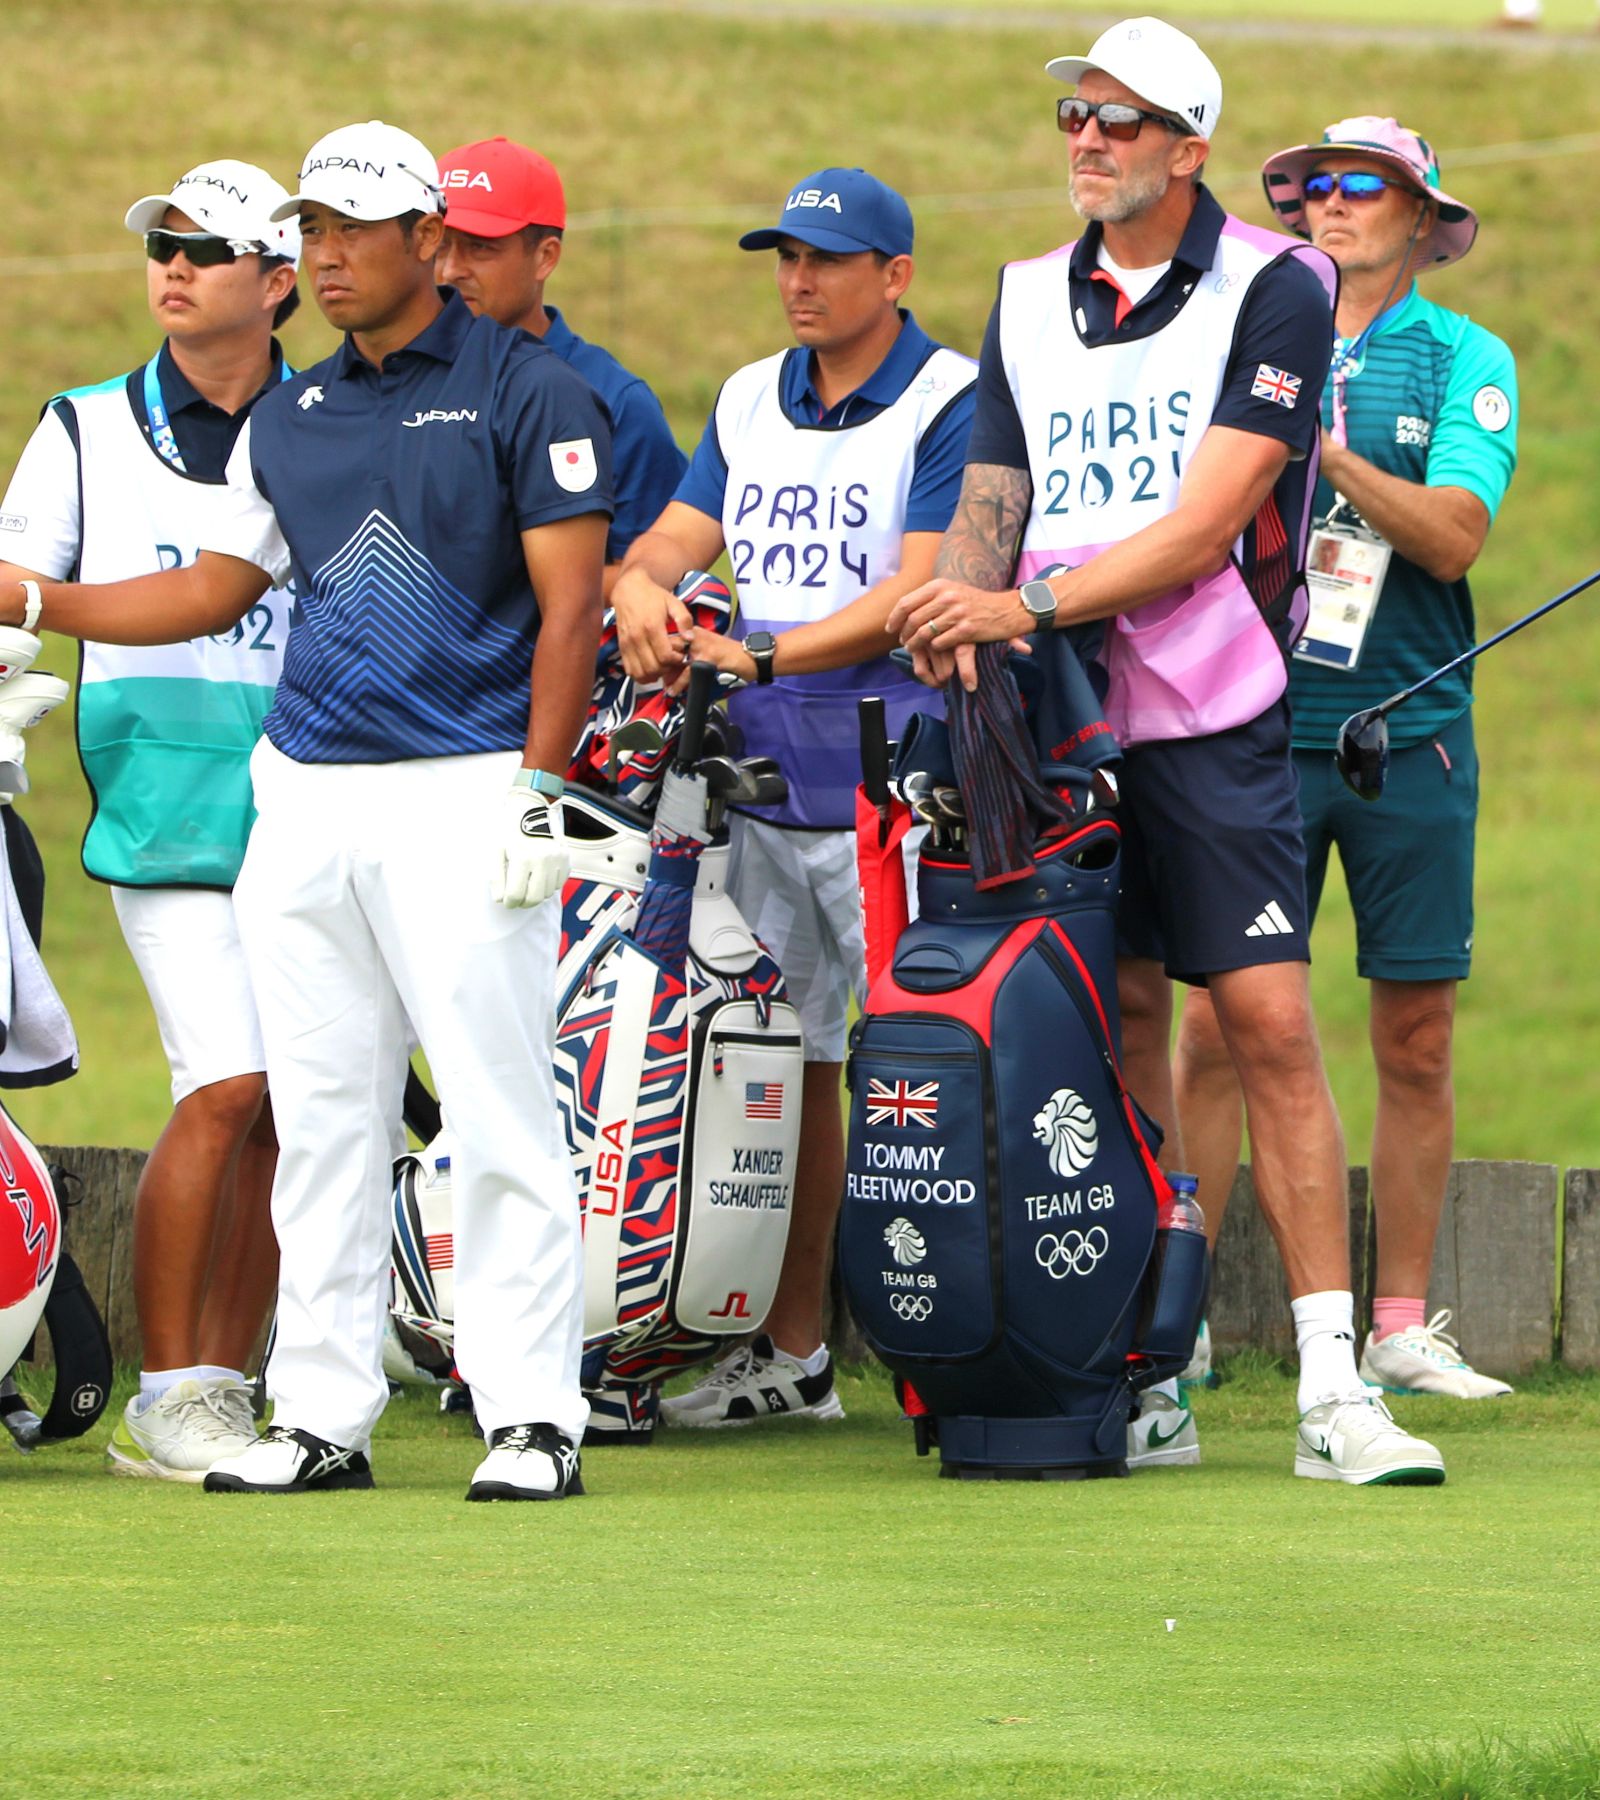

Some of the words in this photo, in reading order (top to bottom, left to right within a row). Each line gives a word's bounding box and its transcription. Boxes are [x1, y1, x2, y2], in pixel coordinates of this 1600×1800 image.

[298, 156, 386, 180] JAPAN
[785, 189, 842, 214] USA
[401, 408, 478, 428] JAPAN
[733, 539, 868, 588] 2024
[592, 1118, 628, 1217] USA
[730, 1148, 784, 1174] XANDER
[864, 1142, 946, 1172] TOMMY
[709, 1181, 789, 1210] SCHAUFFELE
[847, 1173, 977, 1205] FLEETWOOD
[1025, 1190, 1082, 1221] TEAM
[1087, 1184, 1116, 1212] GB
[881, 1271, 915, 1288] TEAM
[917, 1274, 938, 1289] GB
